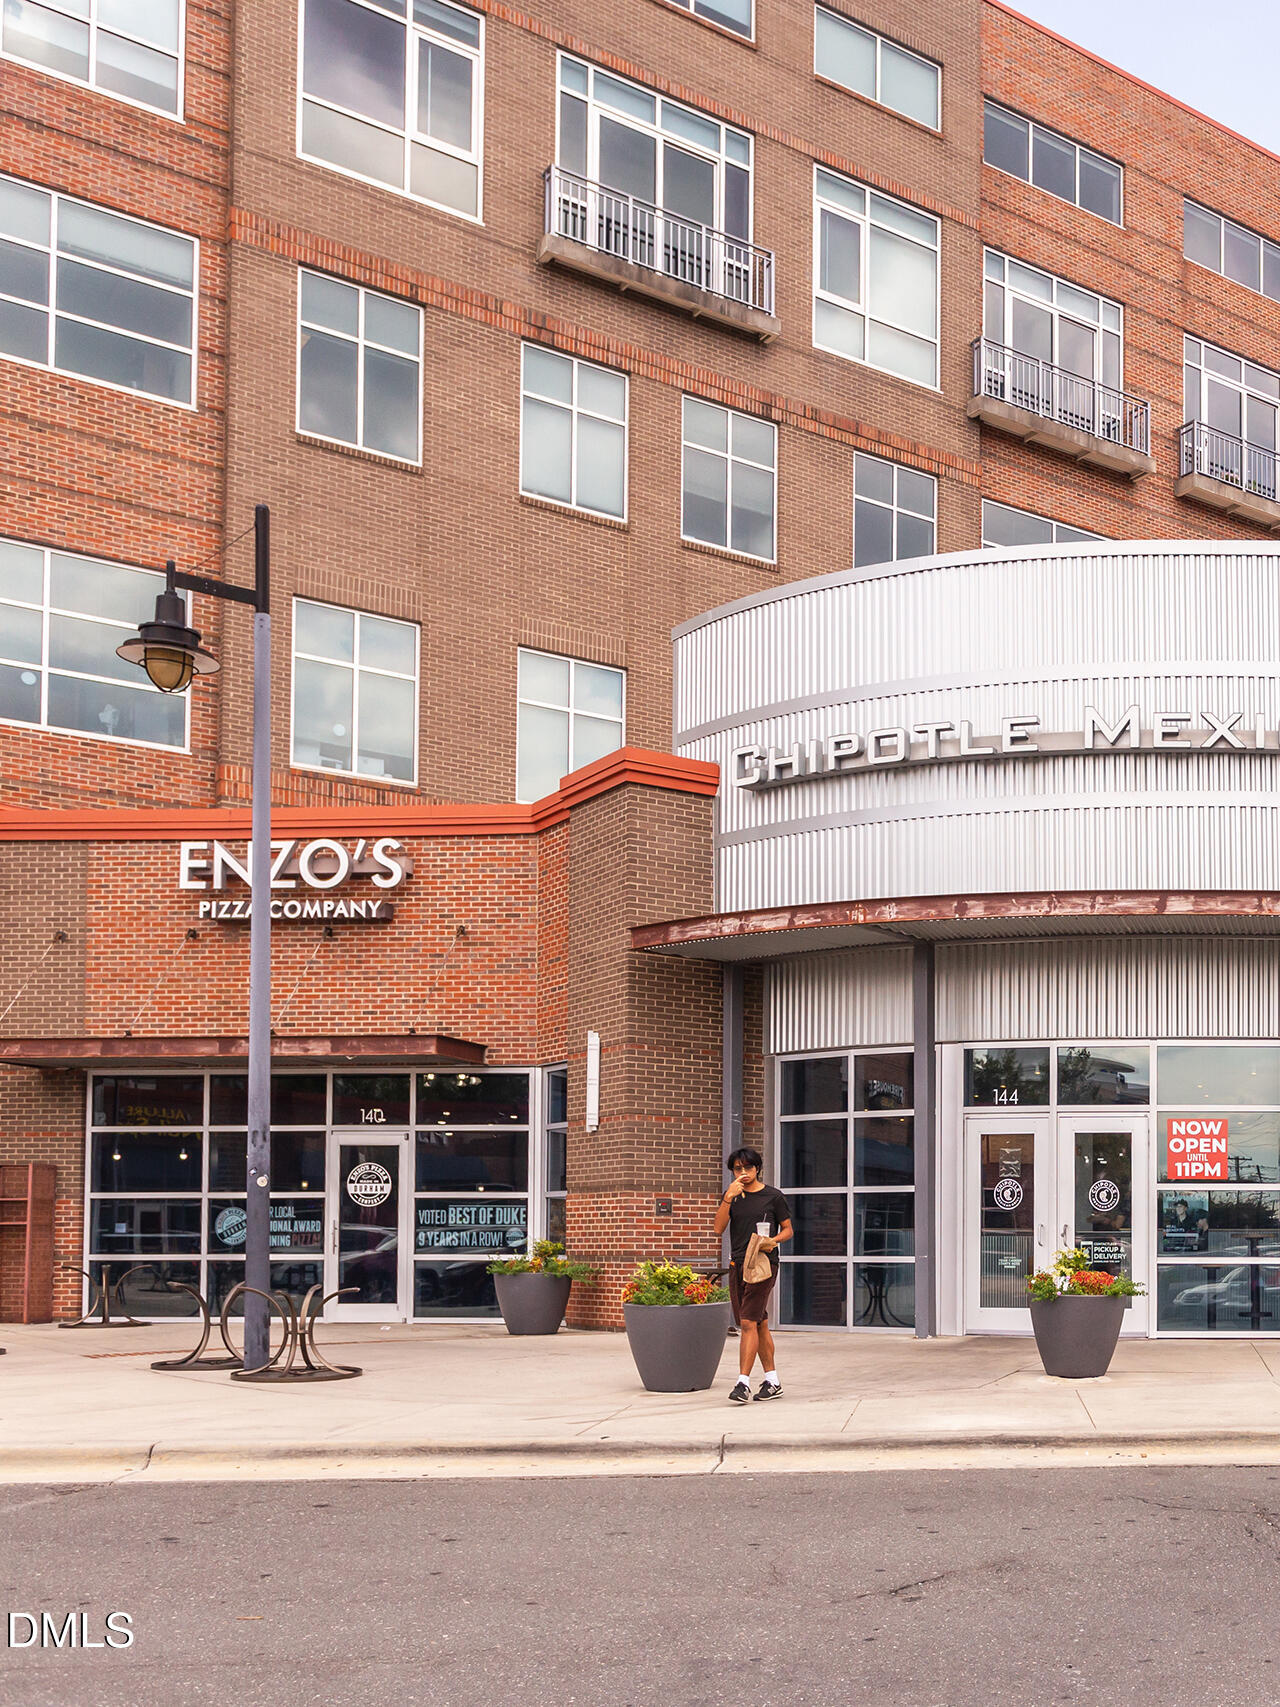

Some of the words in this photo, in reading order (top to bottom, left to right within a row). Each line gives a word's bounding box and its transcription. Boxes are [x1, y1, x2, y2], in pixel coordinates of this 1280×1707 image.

[731, 714, 1041, 790] CHIPOTLE
[179, 837, 403, 889] ENZO'S
[270, 900, 382, 919] COMPANY
[993, 1088, 1019, 1105] 144
[1172, 1121, 1223, 1135] NOW
[1169, 1138, 1226, 1153] OPEN
[1187, 1153, 1208, 1161] UNTIL
[1175, 1162, 1221, 1177] 11PM
[353, 1184, 385, 1192] DURHAM
[1091, 1182, 1117, 1194] CHIPOTLE
[275, 1206, 296, 1218] LOCAL
[418, 1209, 447, 1225] VOTED
[449, 1207, 477, 1225] BEST
[479, 1207, 494, 1225] OF
[495, 1207, 527, 1225] DUKE
[293, 1220, 321, 1232] AWARD
[418, 1231, 426, 1246] 9
[426, 1231, 459, 1246] YEARS
[460, 1231, 470, 1246] IN
[471, 1231, 478, 1246] A
[480, 1231, 503, 1246] ROW!
